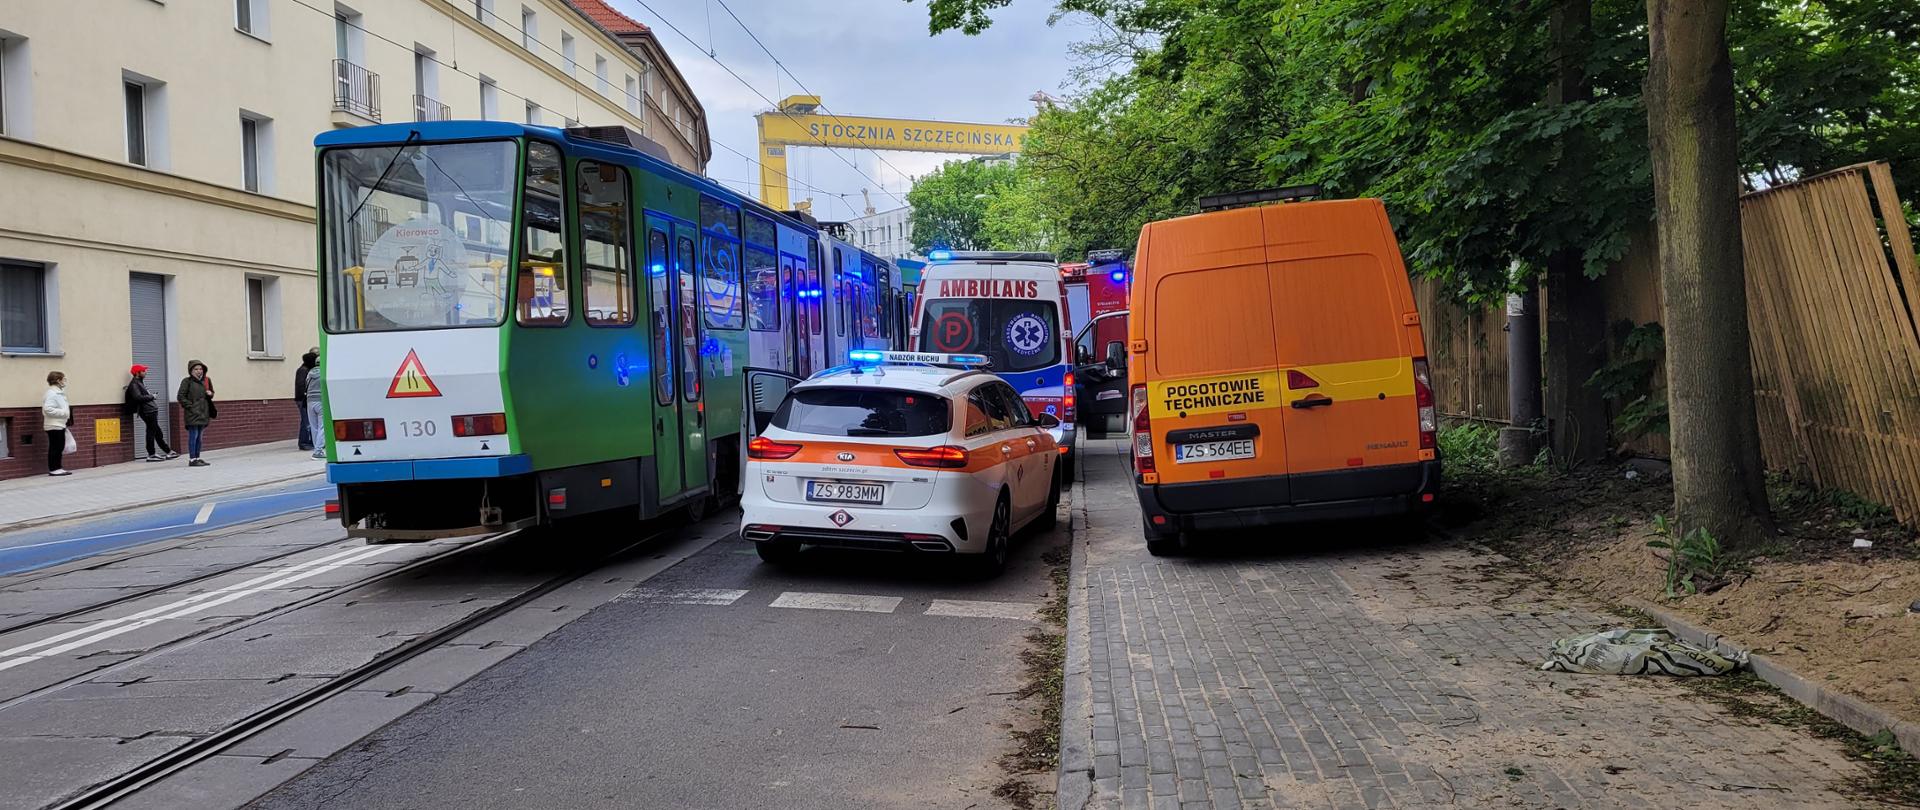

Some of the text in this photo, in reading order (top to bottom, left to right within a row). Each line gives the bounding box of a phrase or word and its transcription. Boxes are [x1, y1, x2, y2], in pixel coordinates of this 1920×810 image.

[809, 122, 1014, 147] STOCZNIA SZCZECIŃSKA
[939, 279, 1038, 298] AMBULANS
[945, 321, 961, 344] P
[889, 353, 940, 363] NADZÓR RUCHU
[1167, 378, 1260, 398] POGOTOWIE
[1164, 391, 1265, 411] TECHNICZNE
[400, 420, 437, 437] 130
[1189, 430, 1237, 439] MASTER
[1185, 440, 1252, 459] ZS 564EE
[815, 484, 833, 498] ZS
[837, 485, 879, 500] 983MM
[837, 514, 845, 522] R
